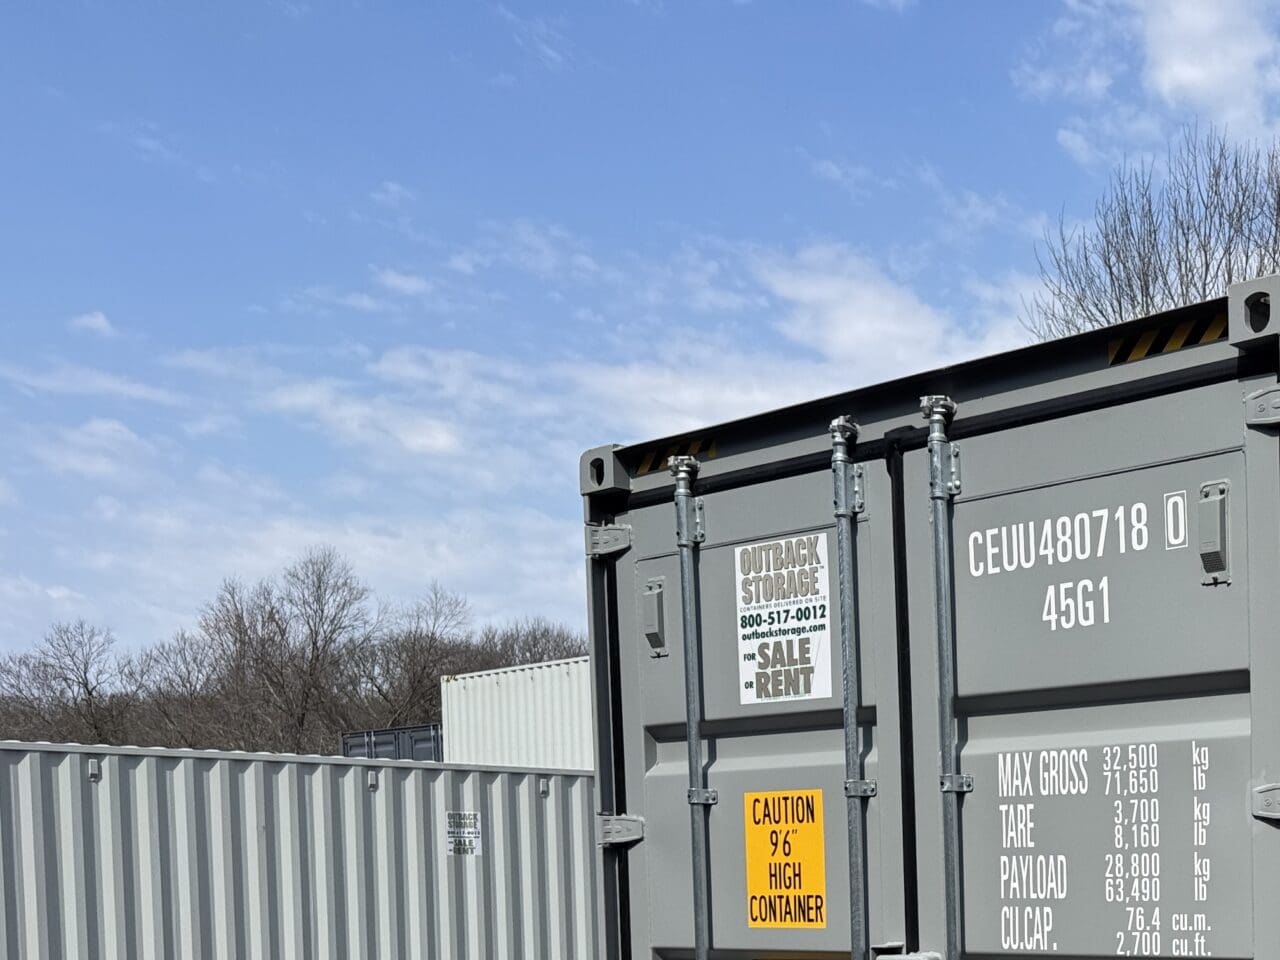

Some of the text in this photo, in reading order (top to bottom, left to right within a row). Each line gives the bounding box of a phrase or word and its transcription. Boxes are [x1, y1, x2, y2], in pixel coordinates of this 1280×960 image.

[968, 496, 1185, 577] CEUU480718 0
[740, 536, 821, 575] OUTBACK
[740, 602, 772, 612] CONTAINERS
[773, 599, 803, 608] DELIVERED
[815, 595, 826, 603] SITE
[740, 604, 827, 629] 800-517-0012
[1042, 576, 1110, 631] 45G1
[742, 624, 826, 641] outbackstorage.com
[743, 637, 811, 670] FOR SALE
[744, 666, 815, 699] OR RENT
[998, 741, 1209, 797] MAX GROSS 32,500 kg
[1103, 766, 1206, 796] 71,650 lb
[752, 795, 815, 825] CAUTION
[1000, 796, 1211, 848] TARE 3,700 kg
[1115, 822, 1207, 850] 8,160 lb
[769, 862, 802, 890] HIGH
[1000, 851, 1211, 899] PAYLOAD 28,800 kg
[1105, 877, 1207, 904] 63,490 lb
[750, 895, 824, 923] CONTAINER
[1001, 905, 1212, 951] CU.CAP. 76.4 cu.m.
[1116, 931, 1212, 957] 2,700 cu.ft.
